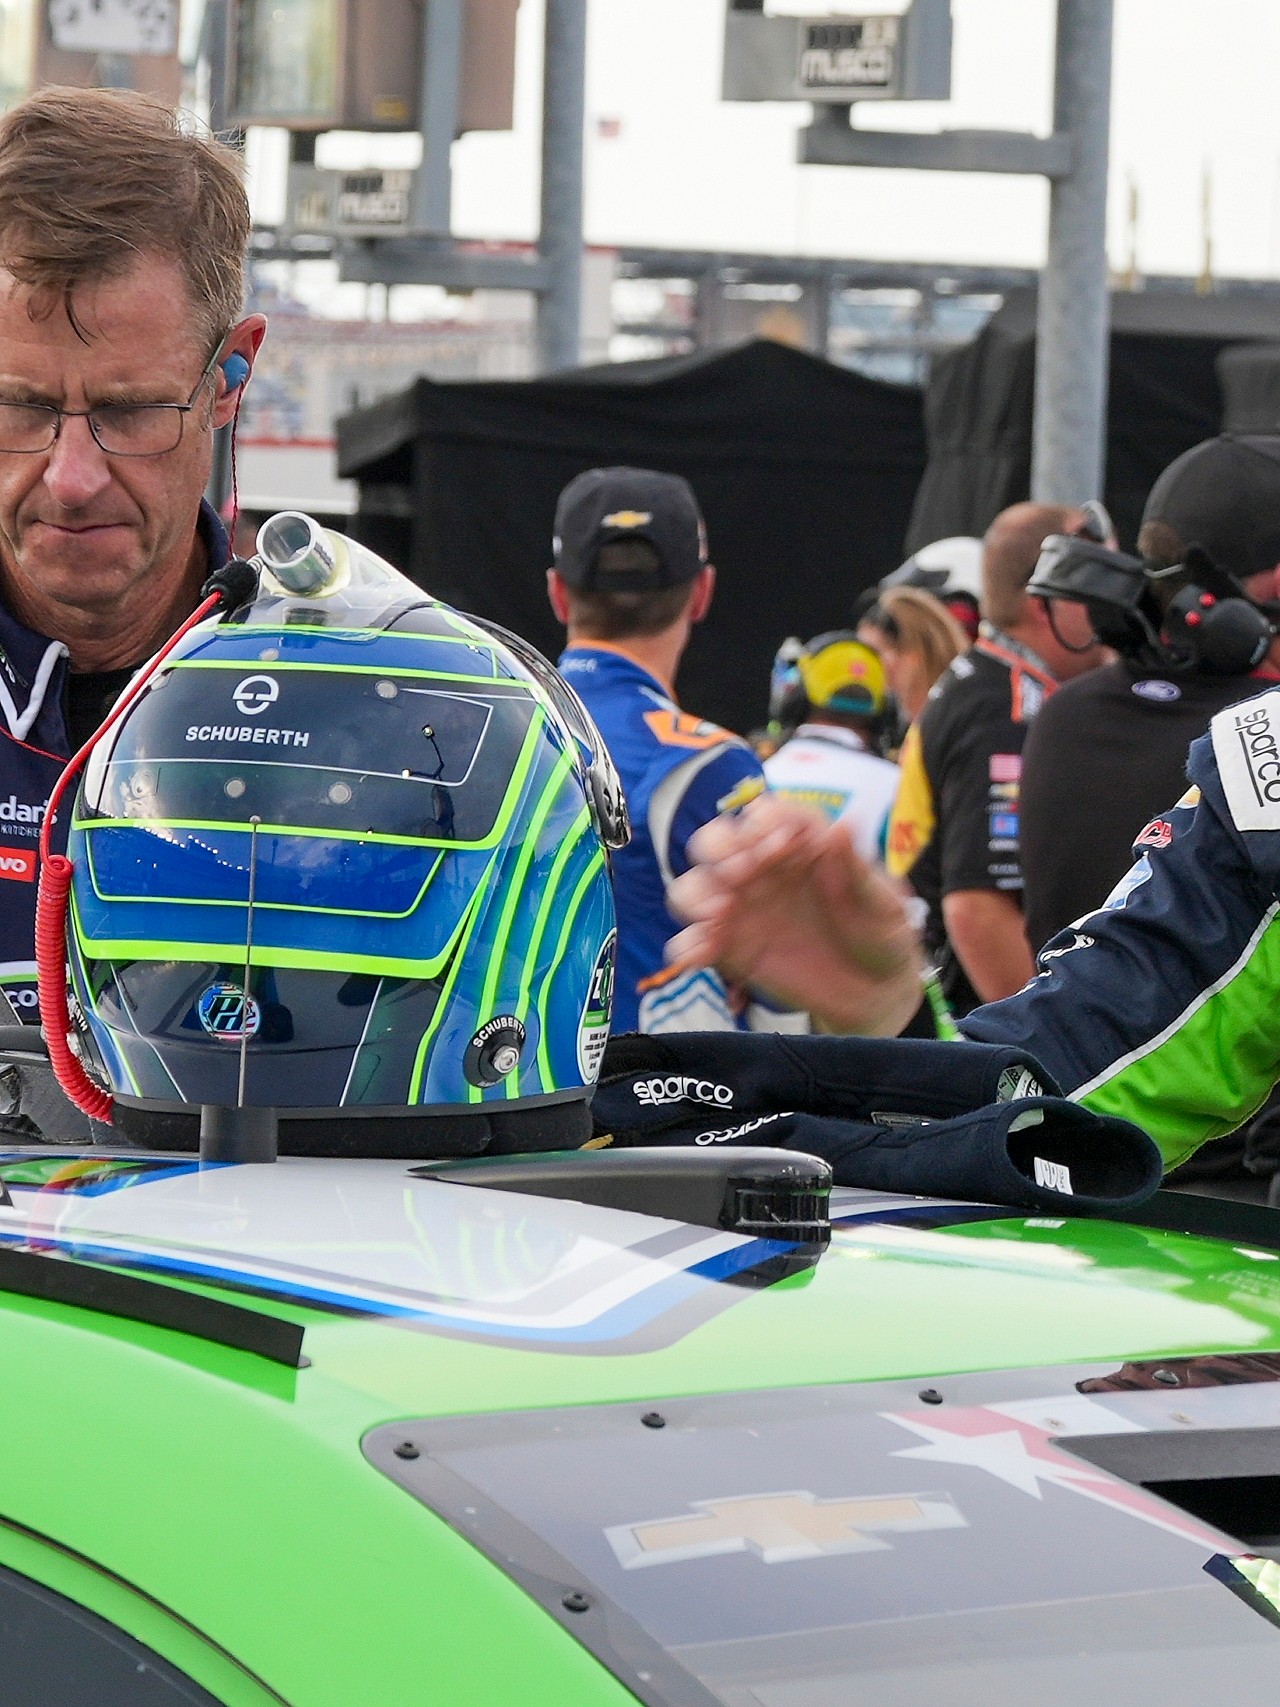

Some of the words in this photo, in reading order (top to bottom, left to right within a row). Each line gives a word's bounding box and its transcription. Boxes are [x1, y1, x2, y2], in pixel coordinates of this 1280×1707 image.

[185, 725, 310, 747] SCHUBERTH
[473, 1016, 526, 1048] SCHUBERTH
[633, 1076, 734, 1107] sparco
